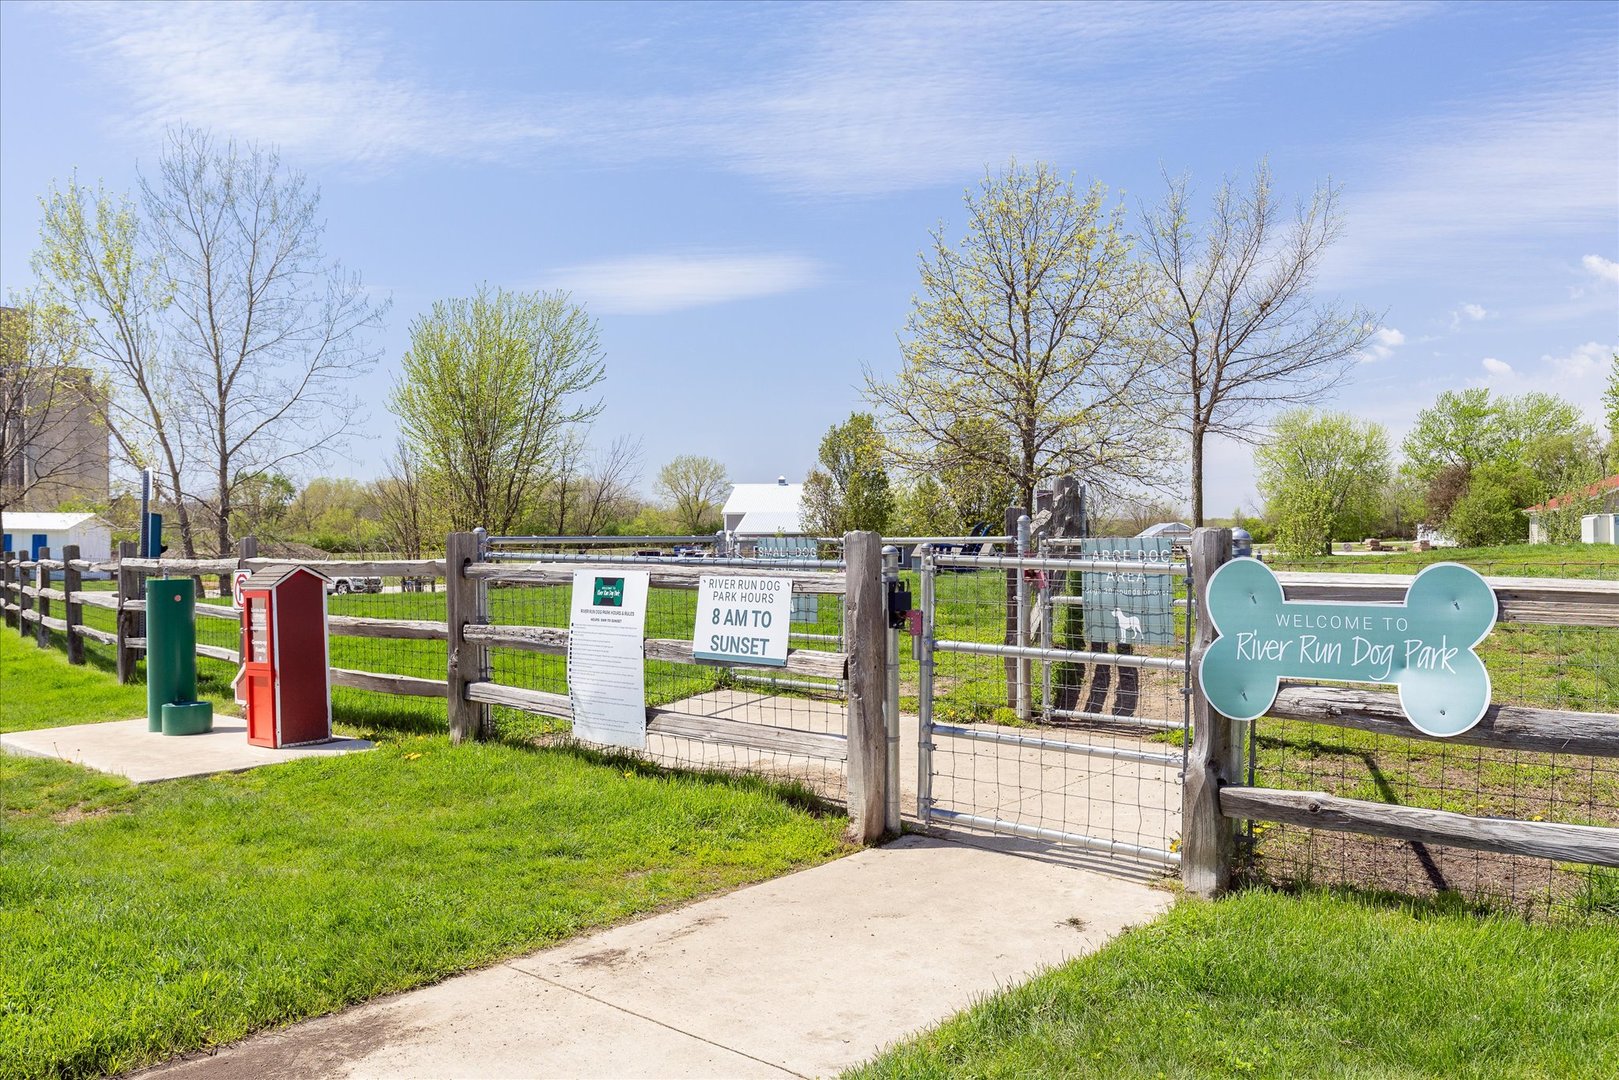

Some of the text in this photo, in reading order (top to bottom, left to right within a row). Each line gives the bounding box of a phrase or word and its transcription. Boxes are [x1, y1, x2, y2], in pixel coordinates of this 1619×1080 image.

[796, 547, 817, 557] DOG
[1137, 549, 1170, 562] DOG
[708, 579, 780, 591] RIVER RUN DOG
[713, 591, 774, 603] PARK HOURS
[712, 608, 772, 628] 8 AM TO
[1276, 614, 1408, 632] WELCOME TO
[710, 634, 770, 655] SUNSET
[1236, 630, 1459, 680] River Run Dog Park
